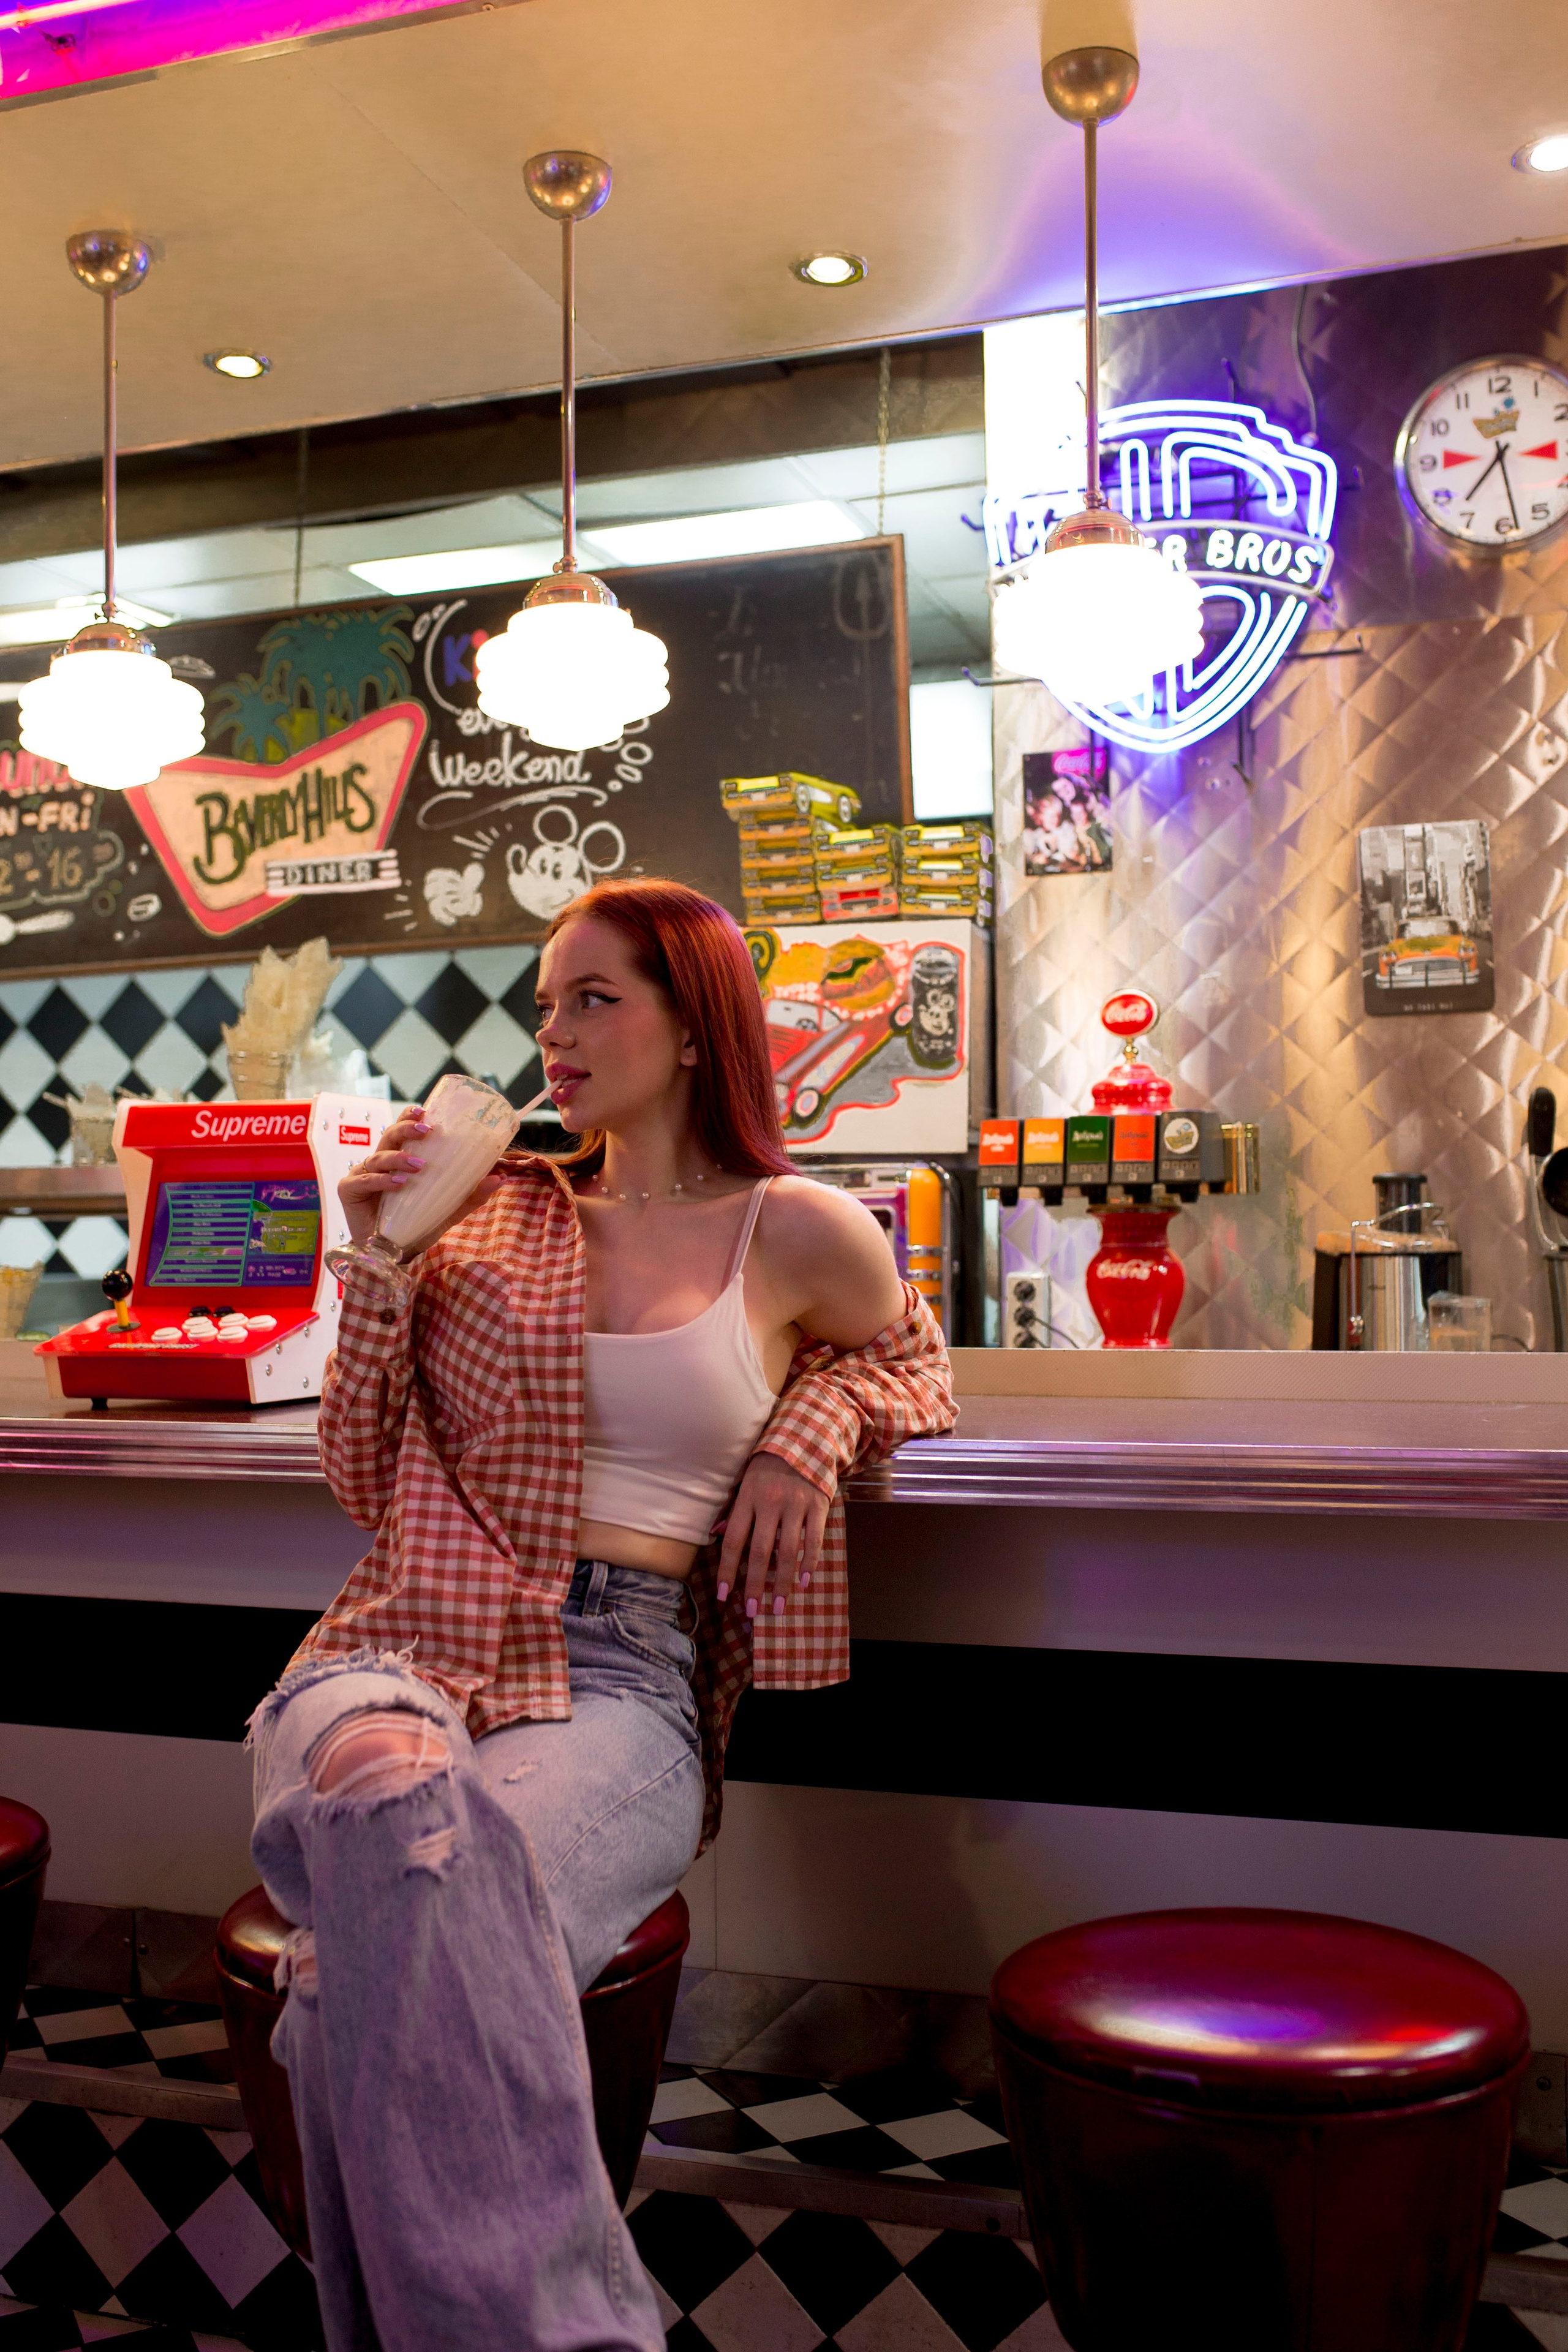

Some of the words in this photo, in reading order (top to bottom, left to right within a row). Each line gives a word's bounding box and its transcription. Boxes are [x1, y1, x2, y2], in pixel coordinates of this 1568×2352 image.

[1488, 375, 1511, 394] 12
[1534, 380, 1539, 398] 1
[1456, 393, 1469, 410] 11
[1431, 419, 1449, 436] 10
[1420, 454, 1437, 472] 9
[1433, 489, 1452, 505] 8
[1531, 503, 1550, 519] 5
[1460, 512, 1474, 529] 7
[1495, 518, 1513, 534] 6
[1205, 529, 1319, 583] BROS
[430, 732, 592, 788] Weekend
[287, 862, 372, 884] DINER
[191, 1109, 306, 1142] Supreme
[340, 1126, 369, 1144] Supreme
